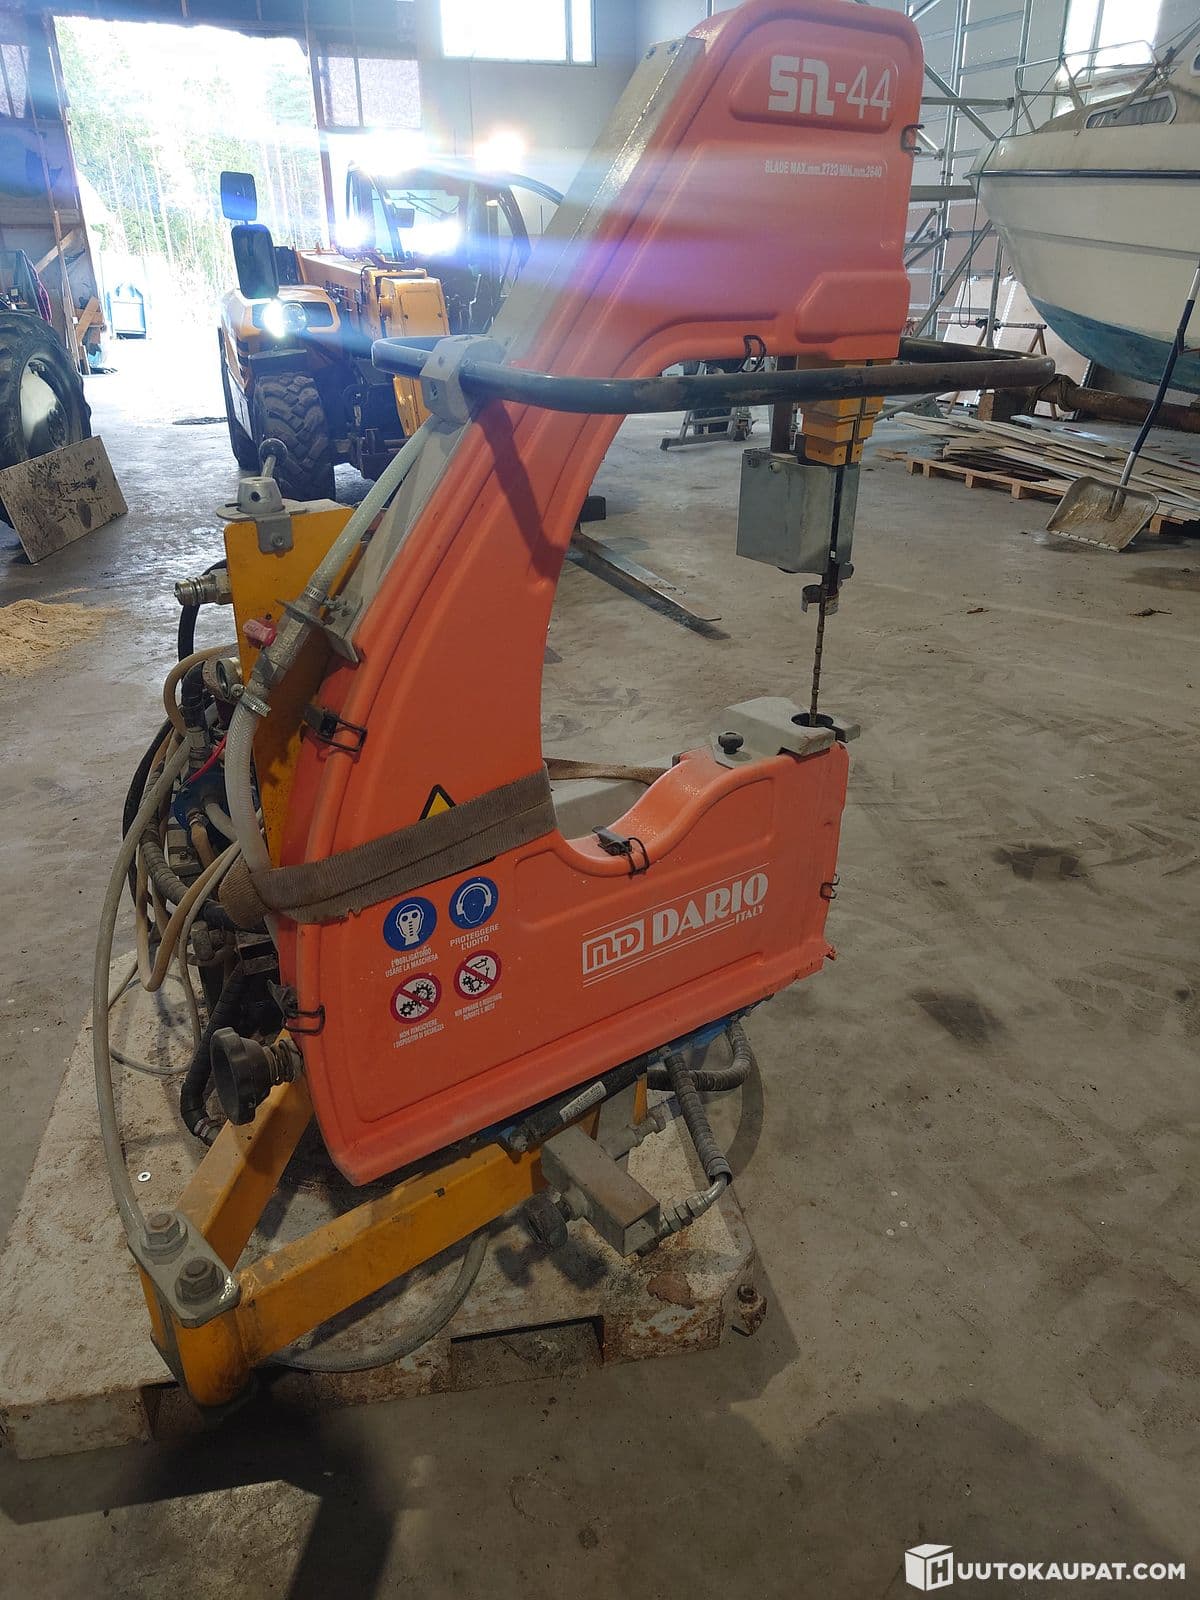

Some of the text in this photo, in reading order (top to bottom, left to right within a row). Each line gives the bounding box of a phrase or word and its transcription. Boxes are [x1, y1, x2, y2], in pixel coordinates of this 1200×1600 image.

[764, 159, 789, 175] BLADE
[652, 872, 769, 946] DARIO
[735, 903, 766, 924] ITALY
[449, 923, 500, 947] PROTEGGERE
[461, 934, 490, 951] L'UDITO
[385, 952, 439, 978] USARE LA MASCHERA
